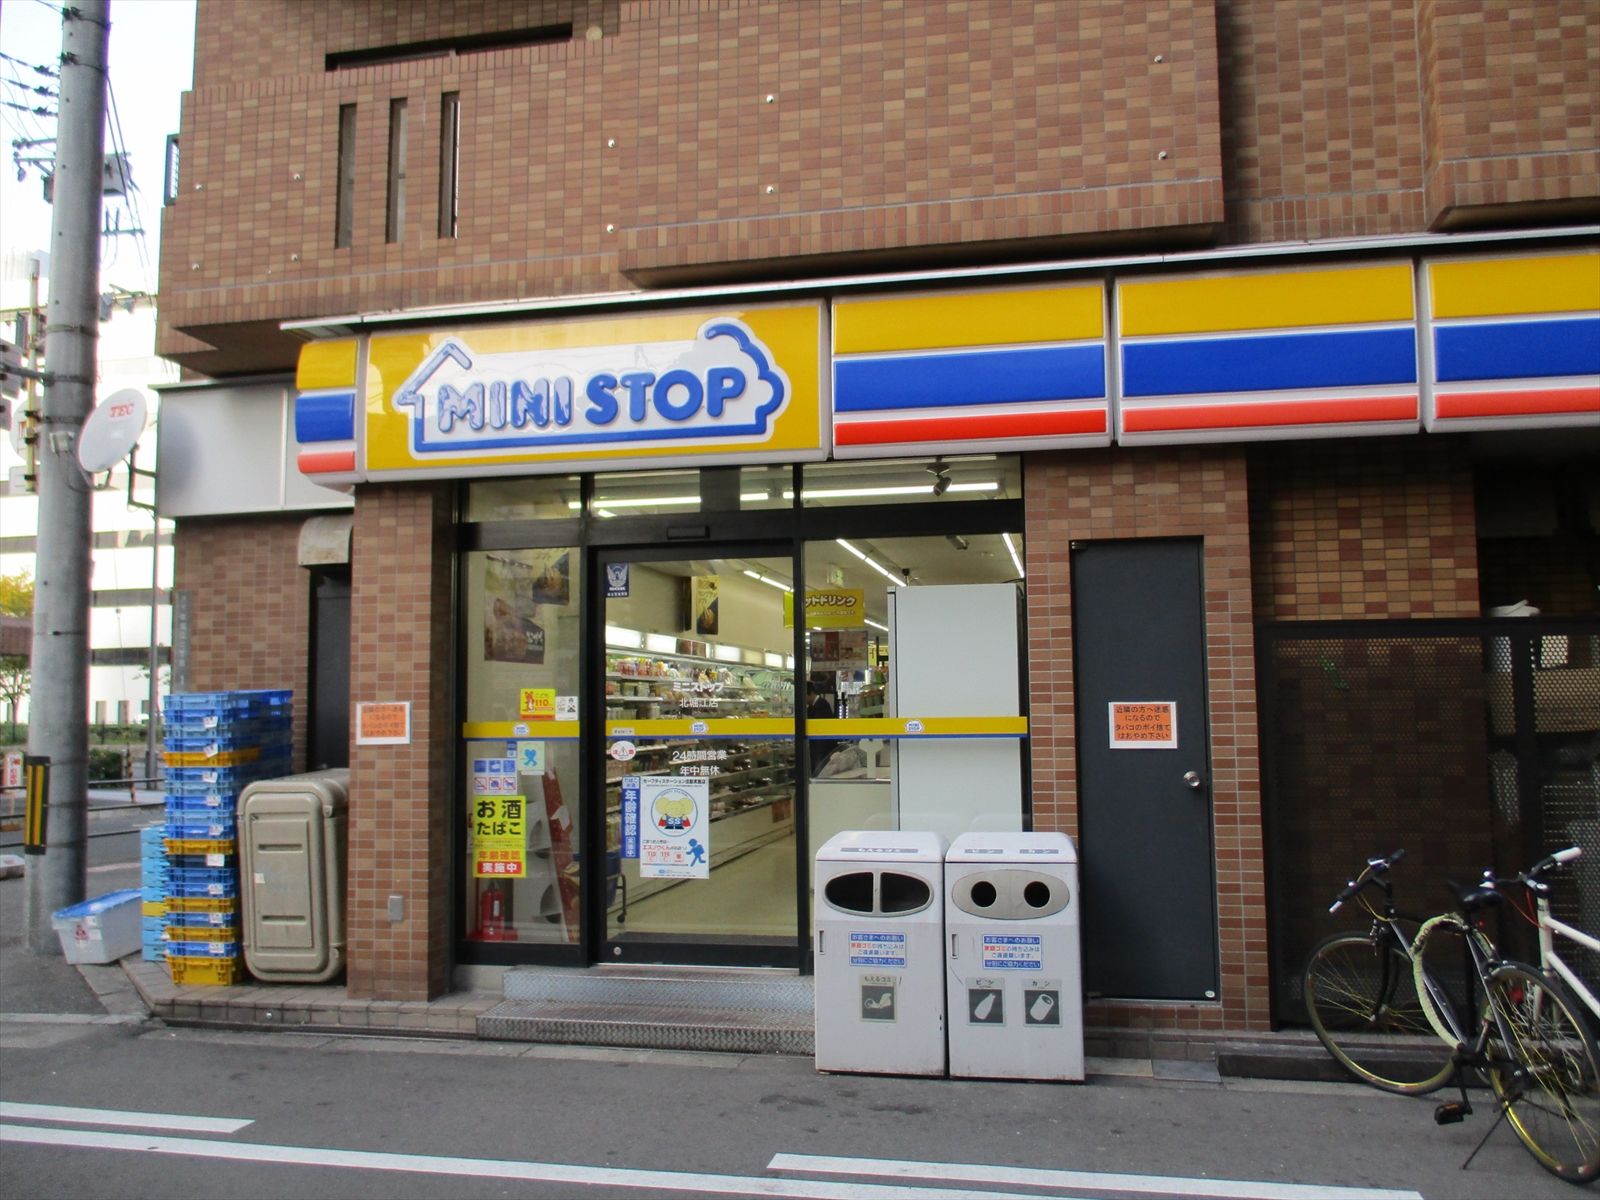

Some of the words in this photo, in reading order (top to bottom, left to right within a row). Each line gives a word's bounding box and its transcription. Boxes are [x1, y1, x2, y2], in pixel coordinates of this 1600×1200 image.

[437, 376, 573, 433] MINI
[584, 366, 747, 426] STOP
[110, 402, 135, 418] TEC
[673, 681, 725, 692] ミニストップ
[679, 697, 719, 708] 北堀江店
[672, 750, 727, 761] 24時間営業
[680, 765, 720, 776] 年中無休
[477, 799, 521, 819] お酒
[625, 790, 637, 836] 年齢確認
[477, 822, 521, 835] たばこ
[479, 850, 521, 860] 年齢確認
[482, 862, 517, 873] 実施中
